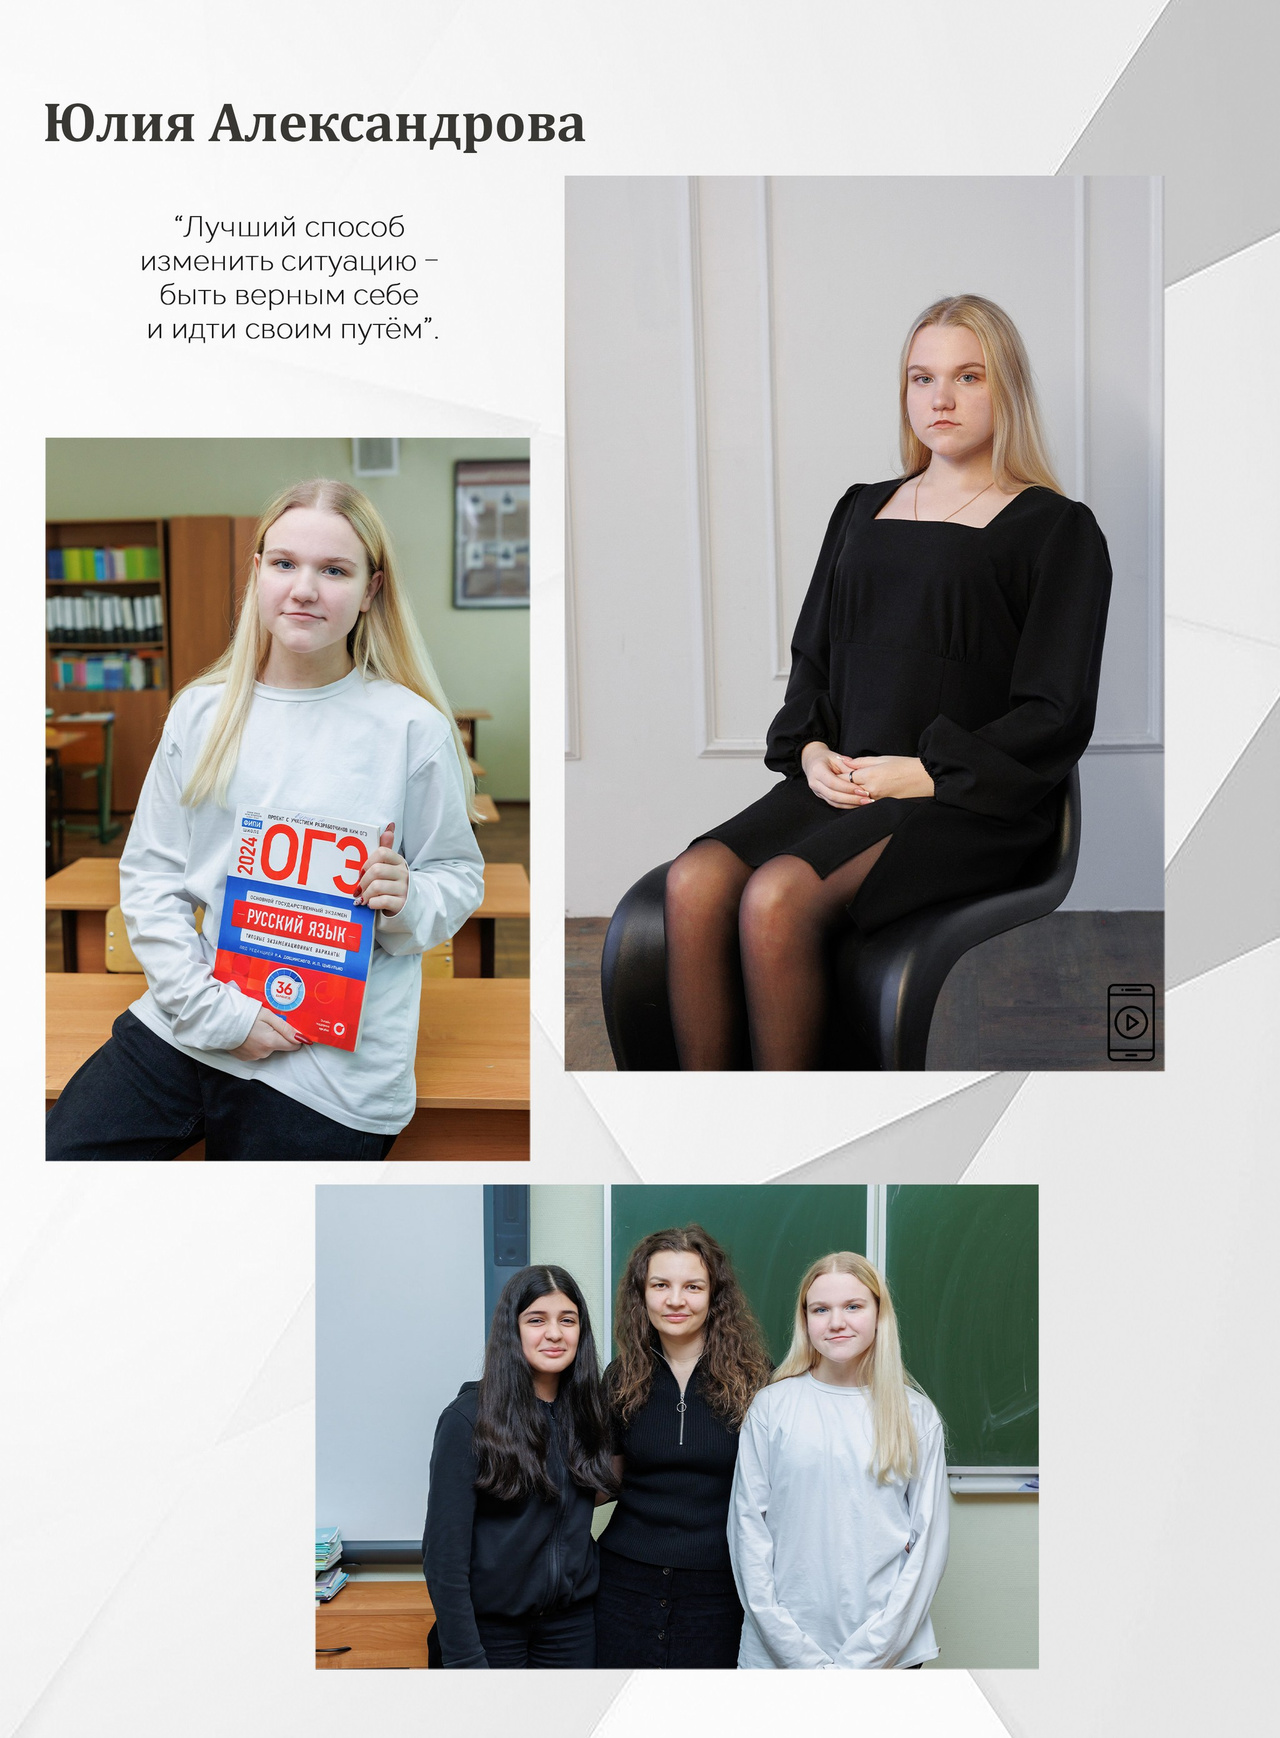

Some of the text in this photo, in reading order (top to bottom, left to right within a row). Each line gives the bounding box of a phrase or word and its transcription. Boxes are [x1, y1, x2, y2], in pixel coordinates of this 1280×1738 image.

[243, 819, 261, 828] ФИПИ
[290, 818, 314, 826] УЧАСТИЕМ
[237, 836, 258, 876] 2024
[260, 823, 369, 895] ОГЭ
[250, 894, 348, 918] ОСНОВНОЙ ГОСУДАРСТВЕННЫЙ ЭКЗАМЕН
[247, 908, 347, 943] РУССКИЙ ЯЗЫК
[245, 932, 265, 943] ТИПОВЫЕ
[314, 947, 341, 958] ВАРИАНТЫ
[275, 980, 293, 996] 36
